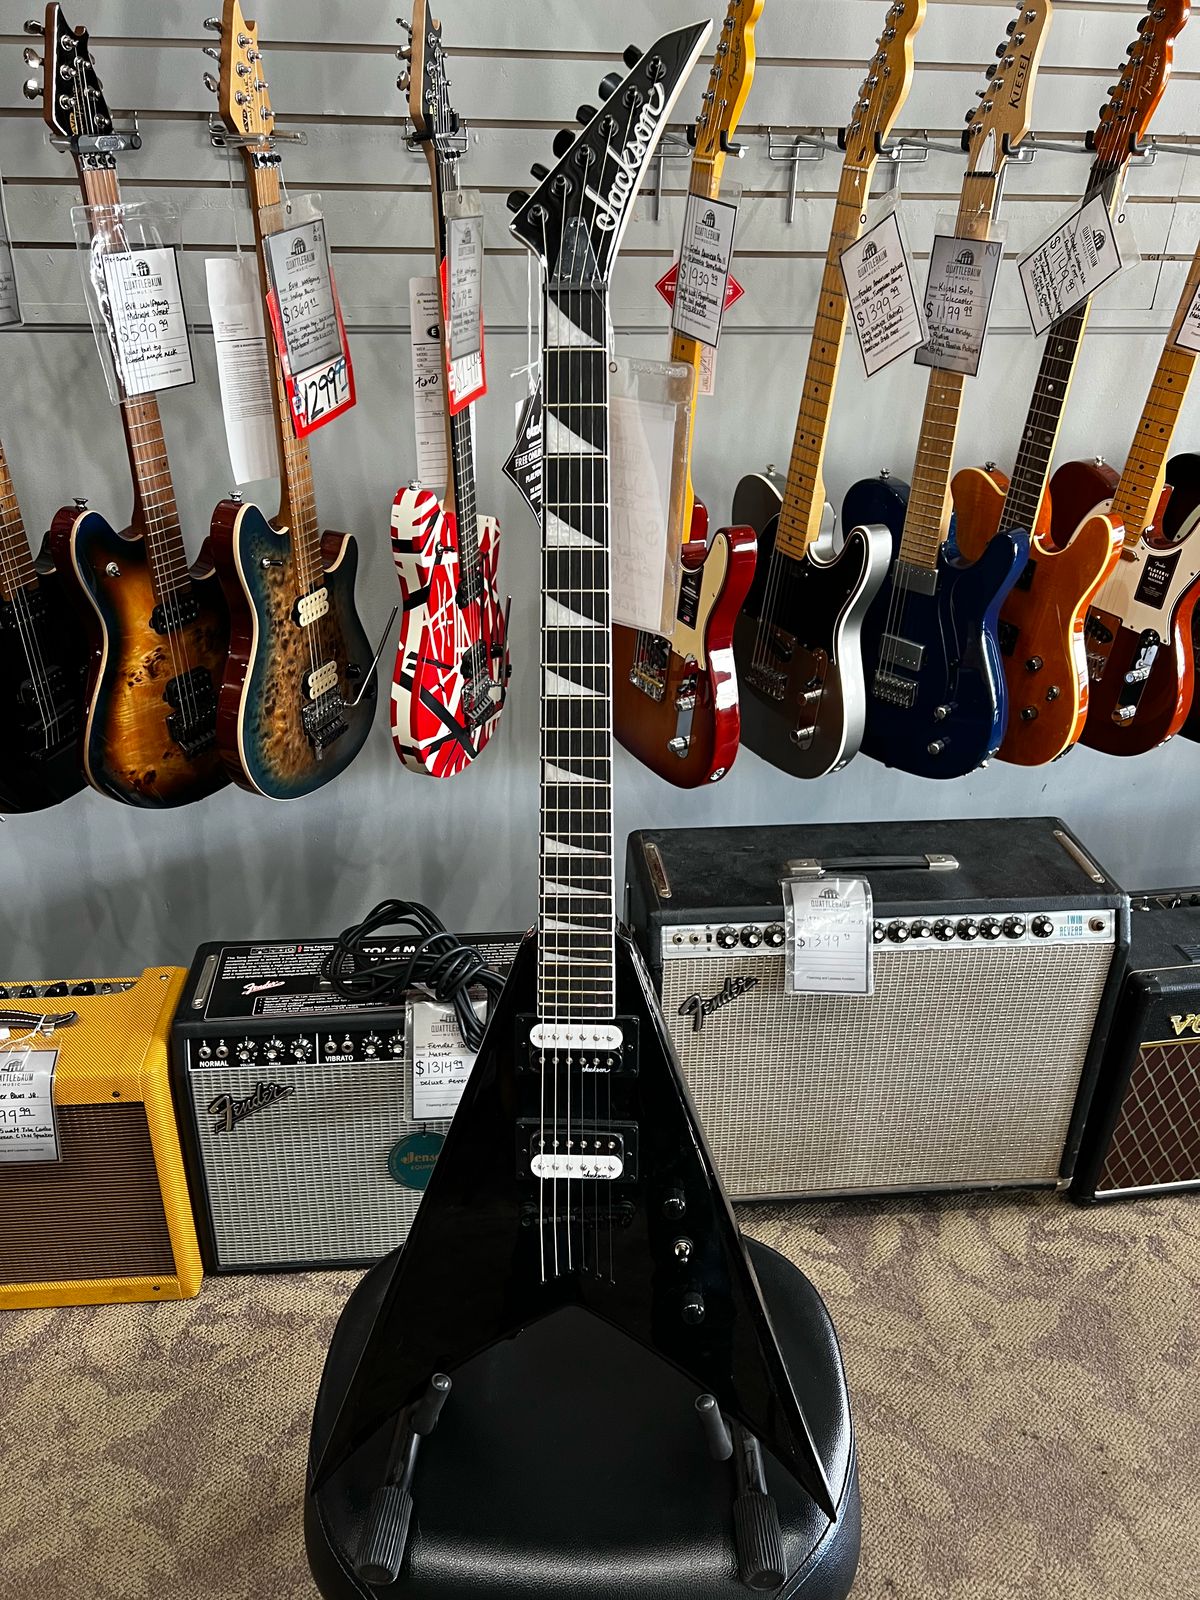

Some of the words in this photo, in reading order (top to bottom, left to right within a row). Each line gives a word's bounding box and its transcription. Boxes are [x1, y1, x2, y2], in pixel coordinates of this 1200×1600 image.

[1008, 51, 1032, 109] KIESEL
[584, 82, 666, 232] Jackson
[857, 248, 888, 278] QUATTLEBAUM
[945, 264, 982, 277] QUATTLEBAUM
[938, 282, 957, 293] Kiesel
[959, 285, 974, 296] Solo
[940, 294, 974, 305] Telecaster
[515, 454, 528, 468] FREE
[1059, 926, 1083, 937] REVERB
[241, 980, 286, 995] Fender
[678, 976, 759, 1032] Fender
[427, 1042, 454, 1050] Fender
[208, 1082, 295, 1134] Fender
